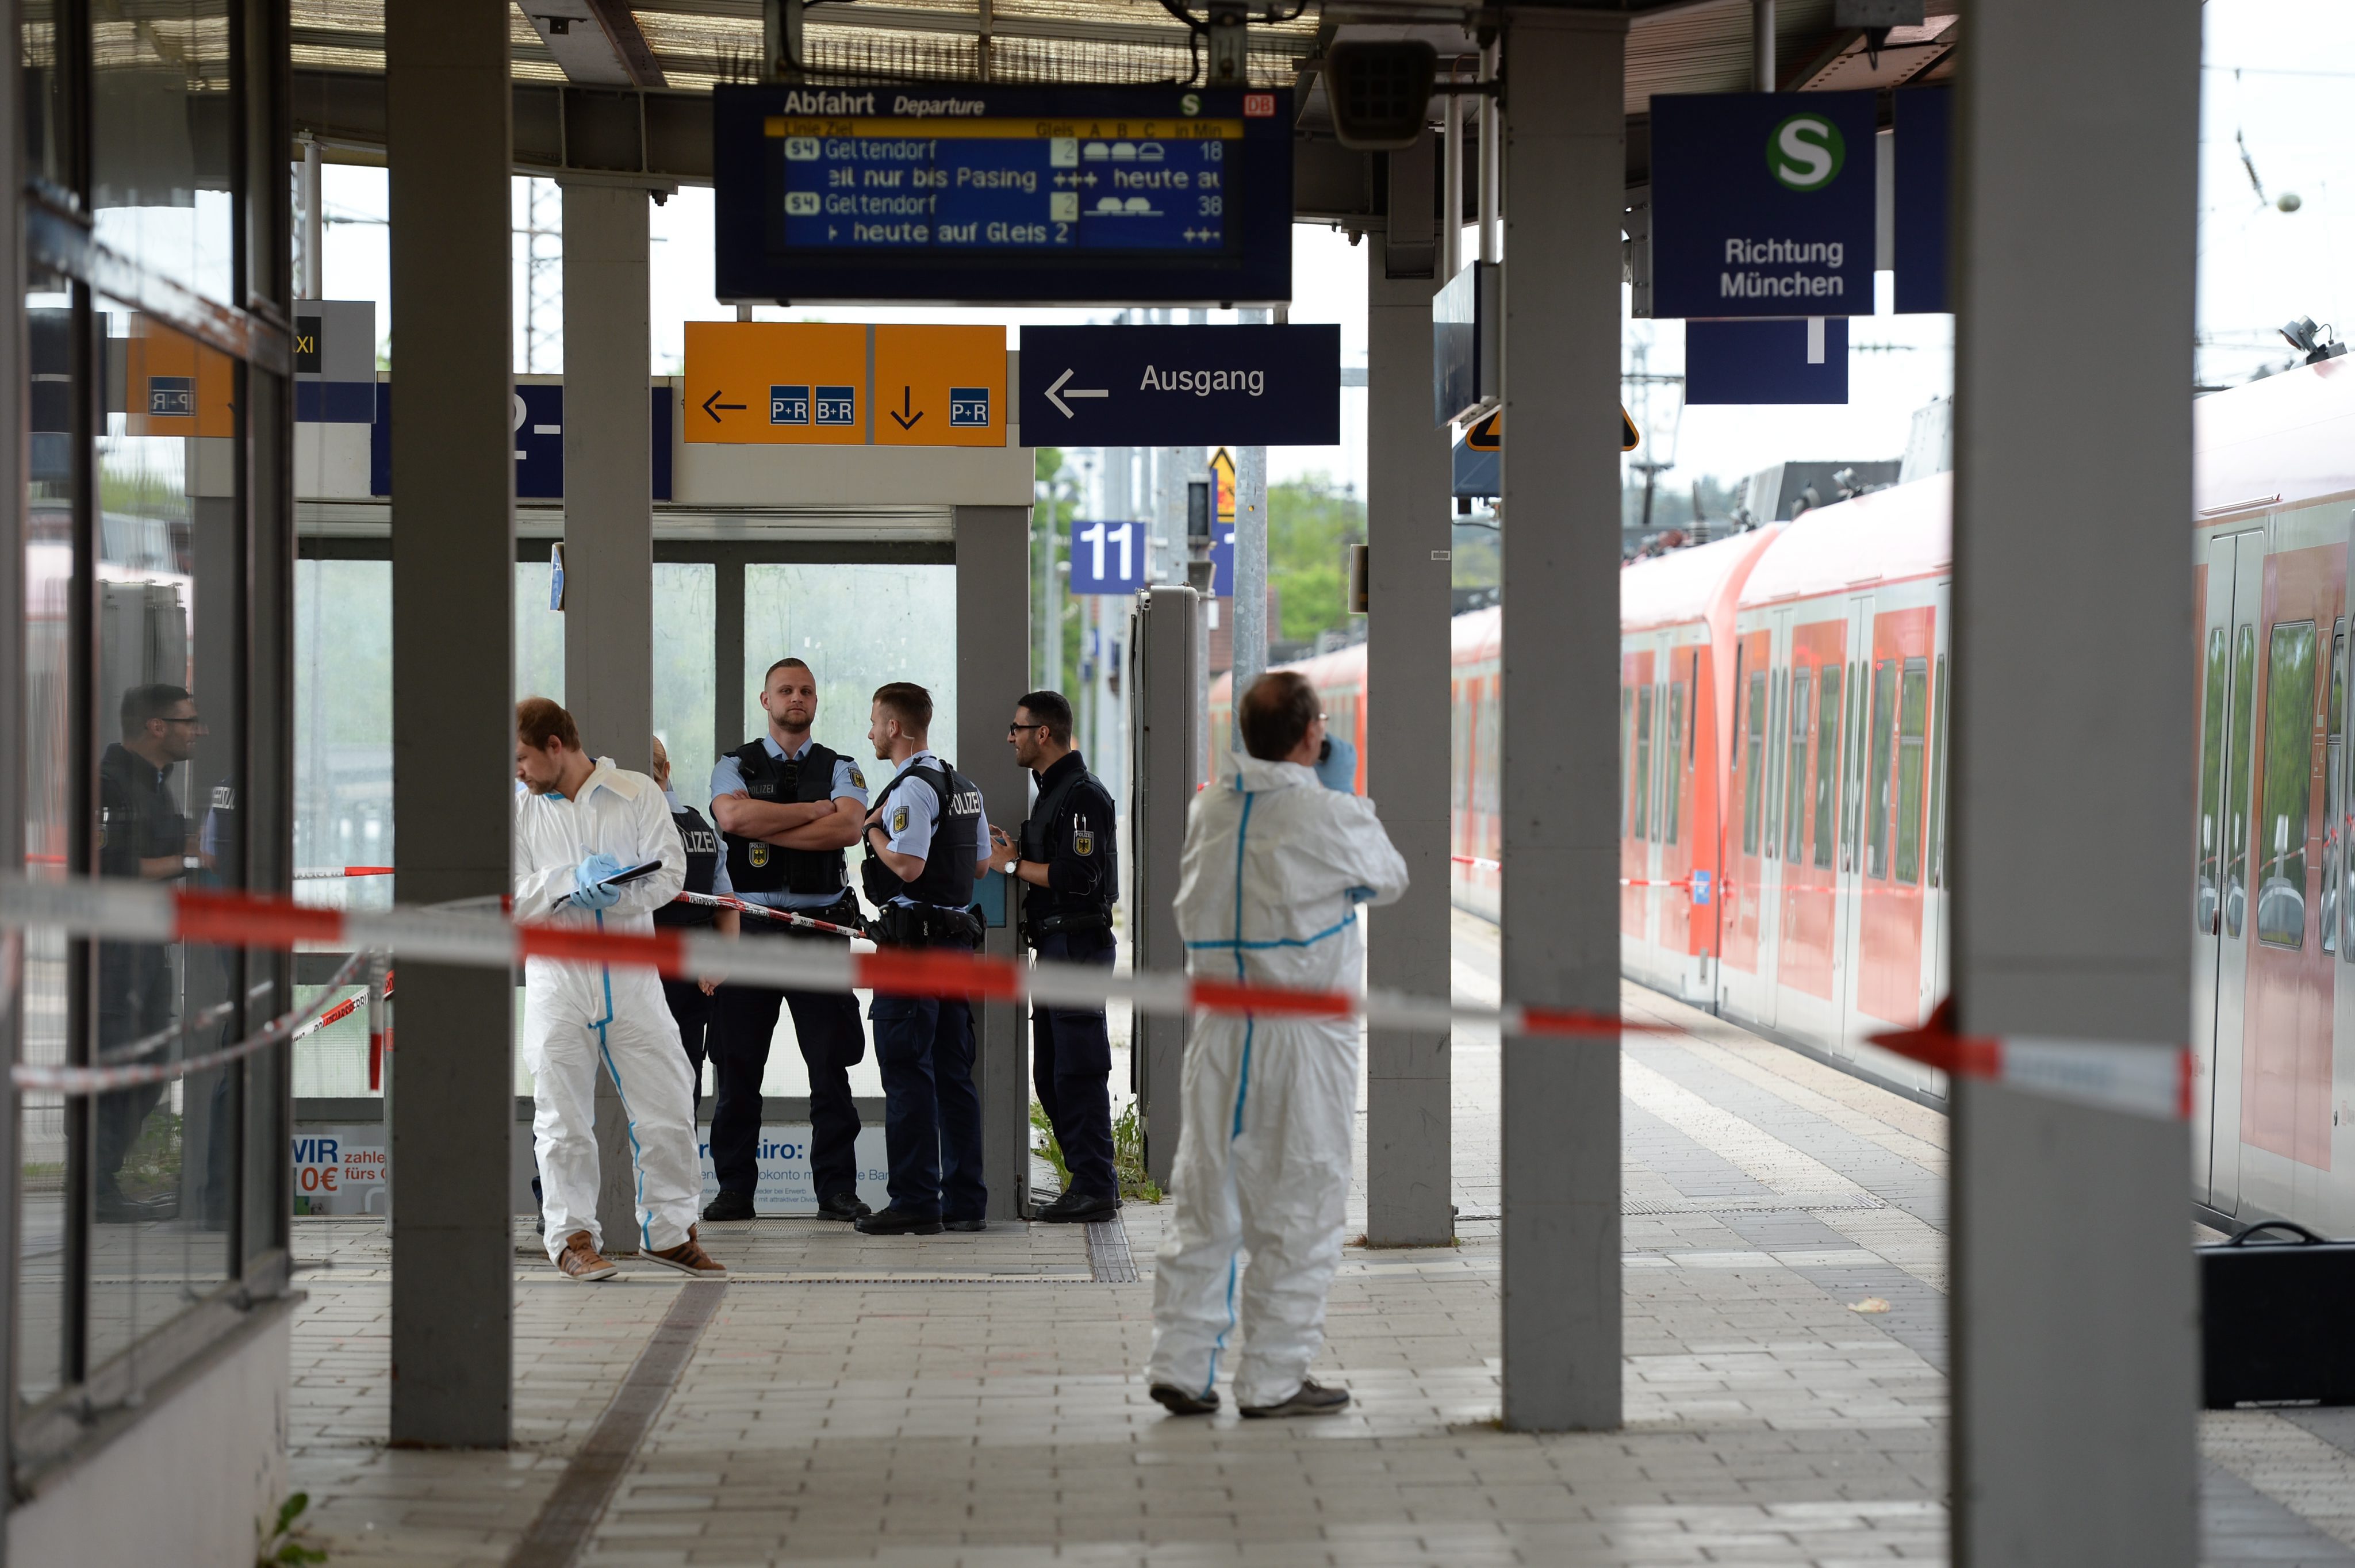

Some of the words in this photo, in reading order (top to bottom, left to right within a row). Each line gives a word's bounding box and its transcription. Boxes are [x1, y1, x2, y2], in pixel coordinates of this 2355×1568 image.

[784, 91, 875, 114] Abfahrt
[893, 95, 985, 117] Departure
[1182, 94, 1199, 116] S
[1246, 95, 1272, 114] DB
[784, 121, 820, 137] Linie
[826, 121, 854, 137] Ziel
[1036, 121, 1075, 137] Gleis
[1089, 122, 1100, 137] A
[1118, 122, 1128, 137] B
[1144, 122, 1155, 137] C
[1194, 122, 1222, 137] Min
[791, 141, 814, 156] S4
[826, 139, 938, 160] Geltendorf
[1064, 141, 1075, 161] 2
[1200, 141, 1223, 161] 18
[1779, 118, 1833, 186] S
[865, 170, 903, 187] nur
[914, 167, 948, 187] bis
[957, 167, 1037, 193] Pasing
[1115, 168, 1189, 189] heute
[791, 196, 814, 212] S4
[826, 194, 938, 215] Geltendorf
[1064, 196, 1075, 216] 2
[1199, 195, 1223, 216] 38
[854, 222, 930, 243] heute
[939, 222, 977, 243] auf
[987, 222, 1046, 243] Gleis
[1055, 222, 1068, 243] 2
[1725, 239, 1844, 268] Richtung
[1721, 272, 1844, 298] München
[293, 335, 314, 354] XI
[1140, 365, 1264, 396] Ausgang
[773, 402, 807, 420] P+R
[817, 402, 852, 420] B+R
[953, 404, 987, 421] P+R
[1080, 522, 1133, 581] 11
[344, 1167, 375, 1179] fürs
